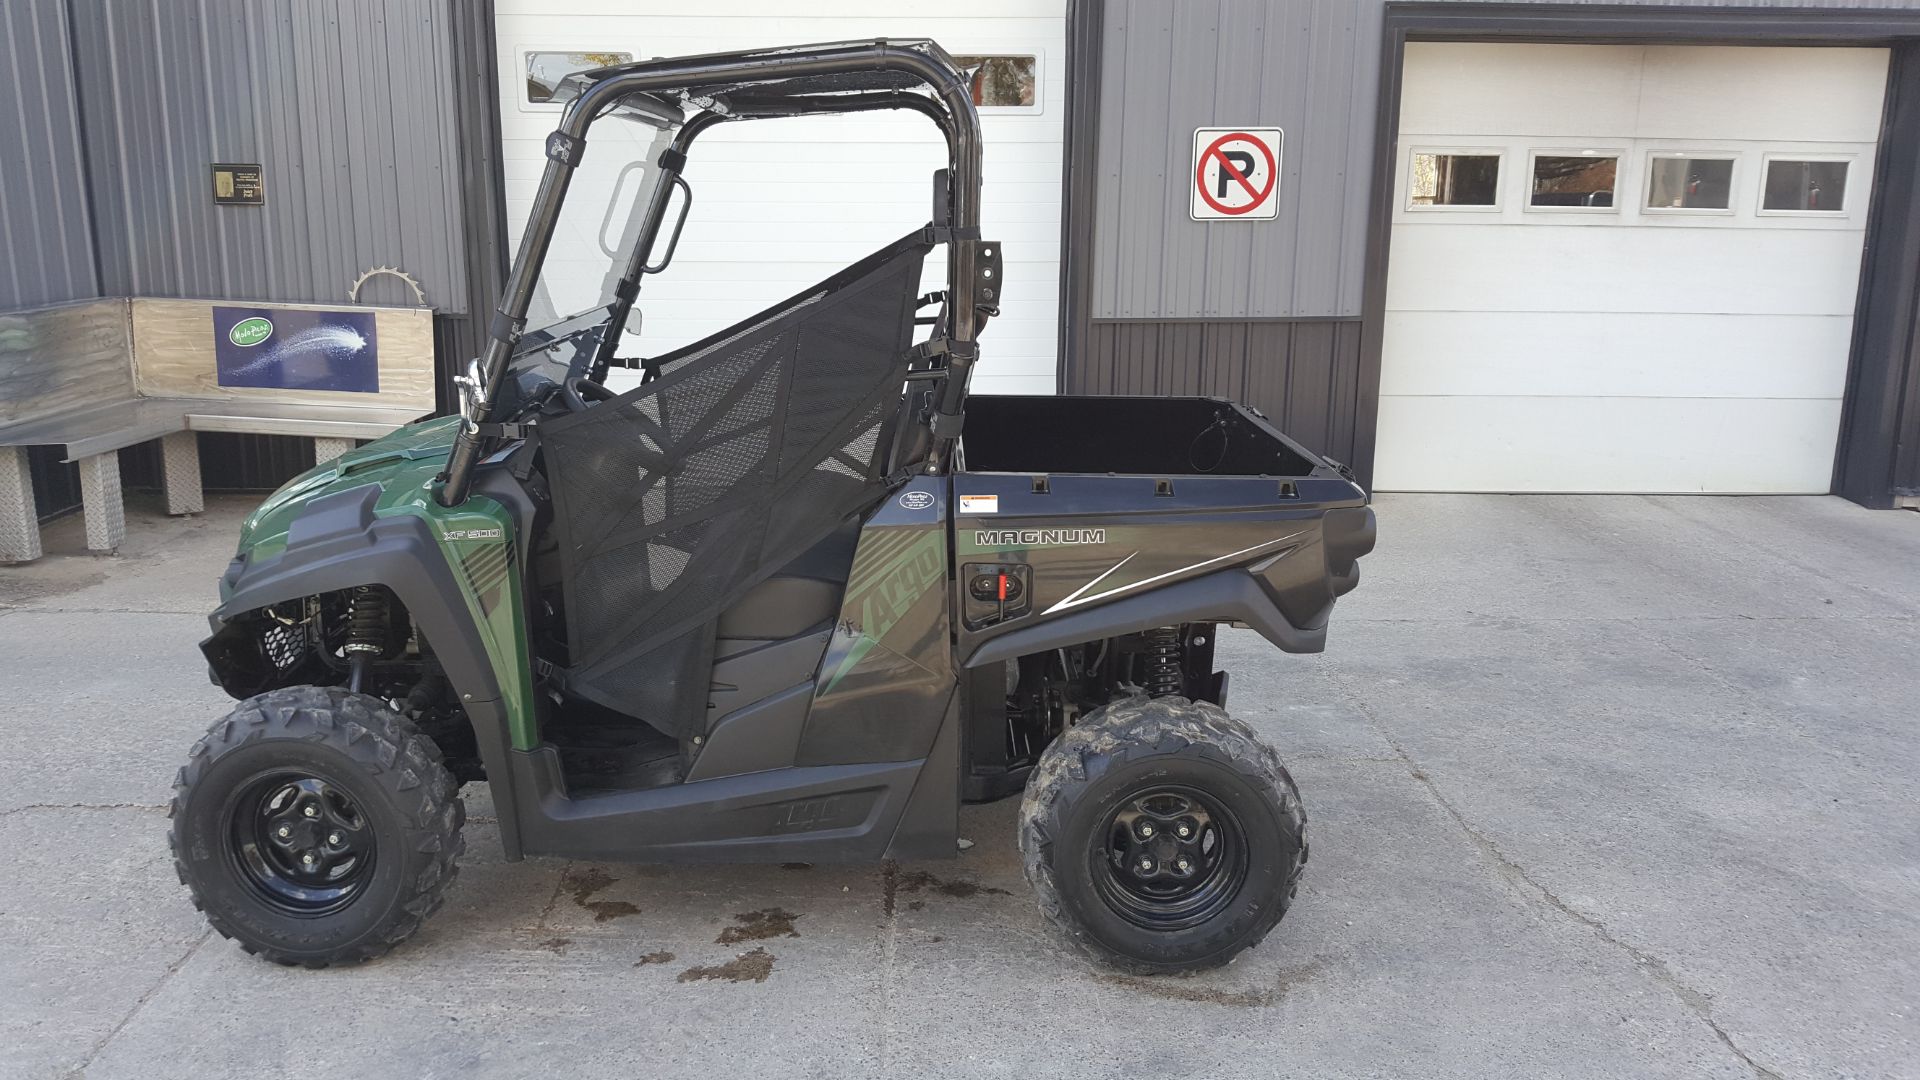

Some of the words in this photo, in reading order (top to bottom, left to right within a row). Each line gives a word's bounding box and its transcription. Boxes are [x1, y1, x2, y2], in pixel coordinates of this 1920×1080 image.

[1217, 150, 1256, 199] P
[444, 531, 465, 540] XF
[468, 529, 500, 538] 500
[975, 529, 1105, 545] MAGNUM
[869, 545, 940, 640] Argo
